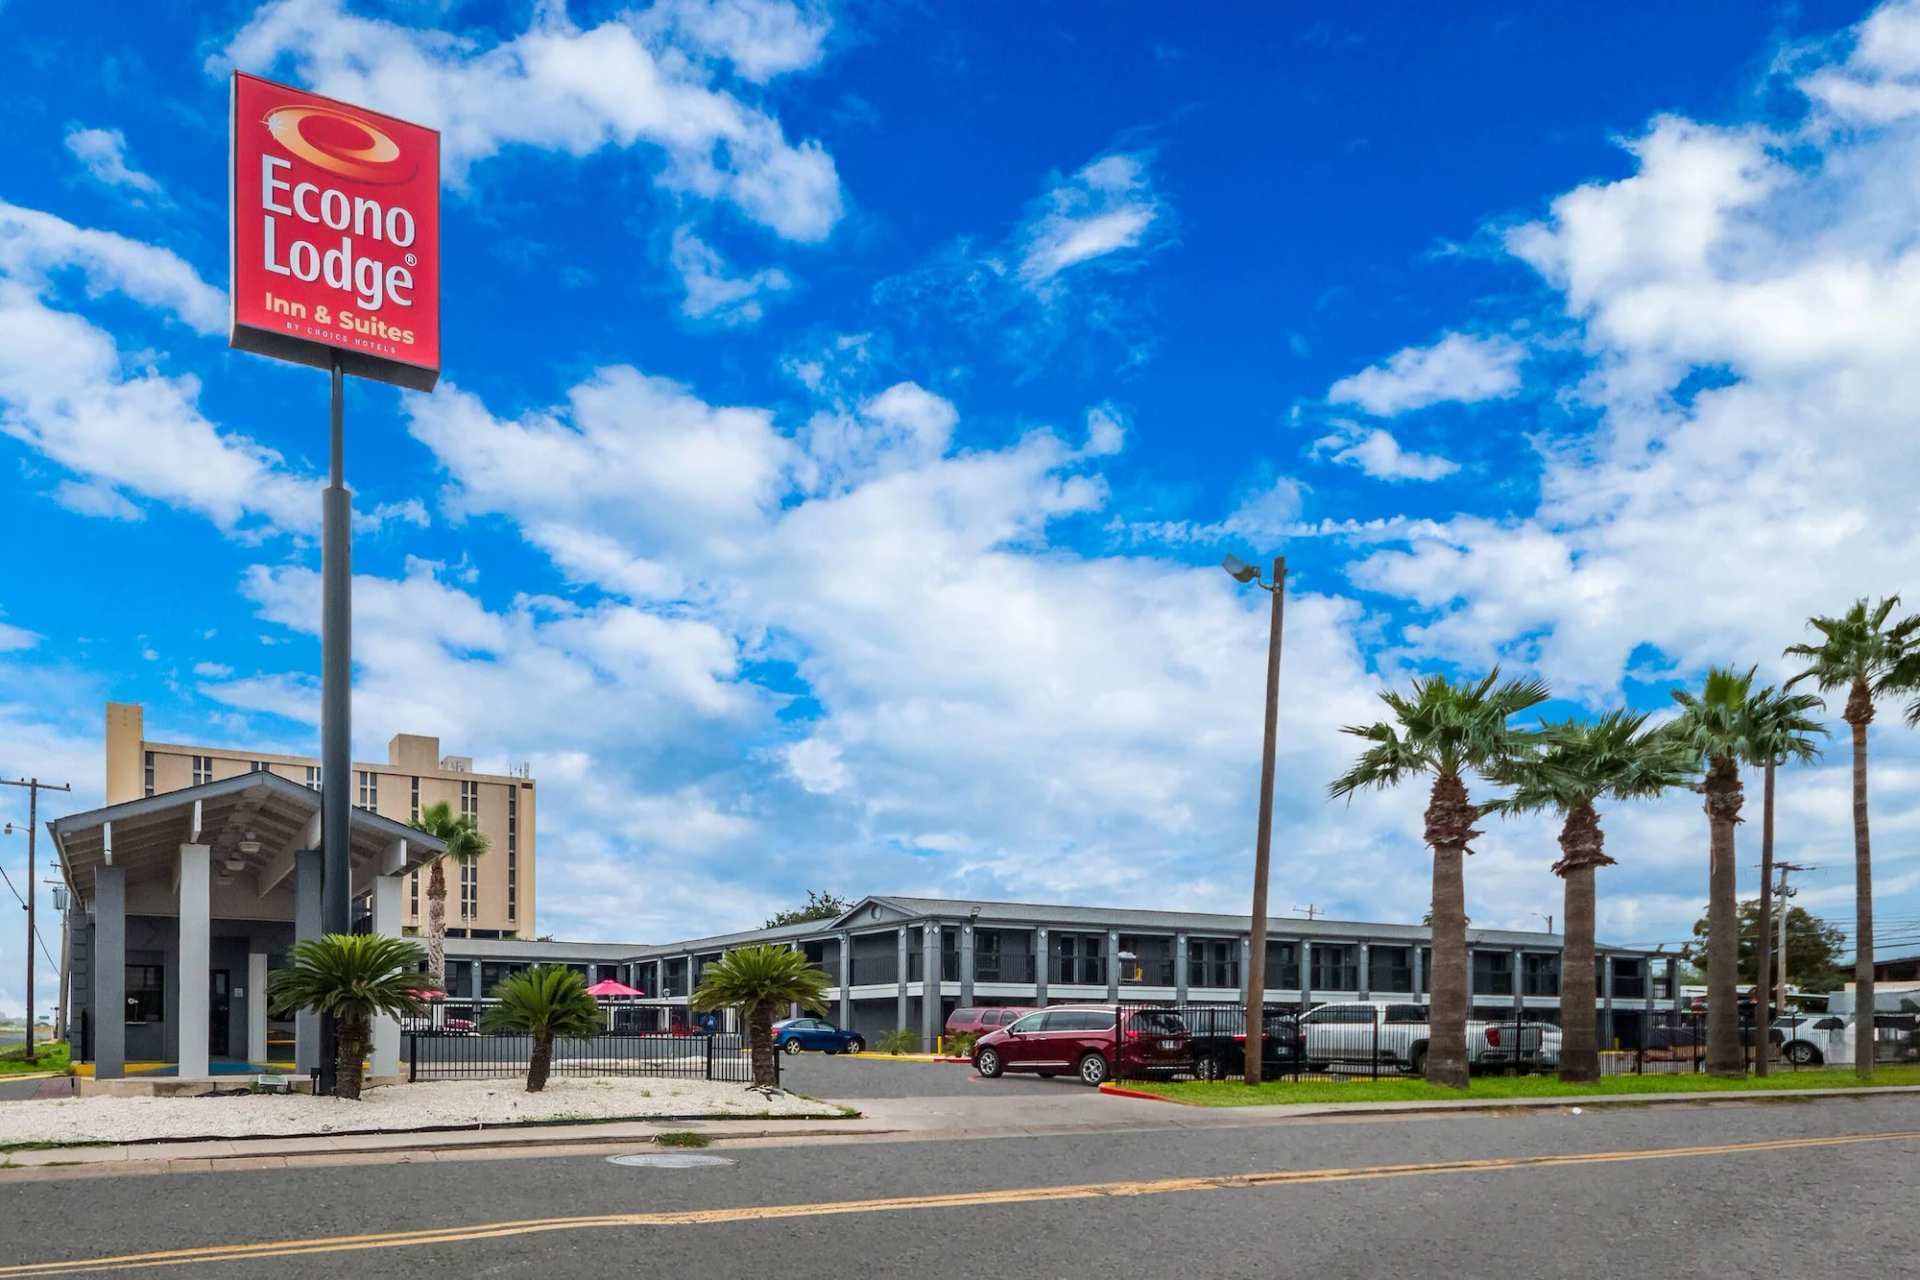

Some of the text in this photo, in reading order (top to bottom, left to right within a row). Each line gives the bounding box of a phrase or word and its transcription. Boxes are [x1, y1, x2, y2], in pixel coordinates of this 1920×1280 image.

[262, 153, 415, 248] Econo
[265, 292, 415, 345] Inn & Suites
[286, 322, 397, 354] BY CHOICE HOTELS
